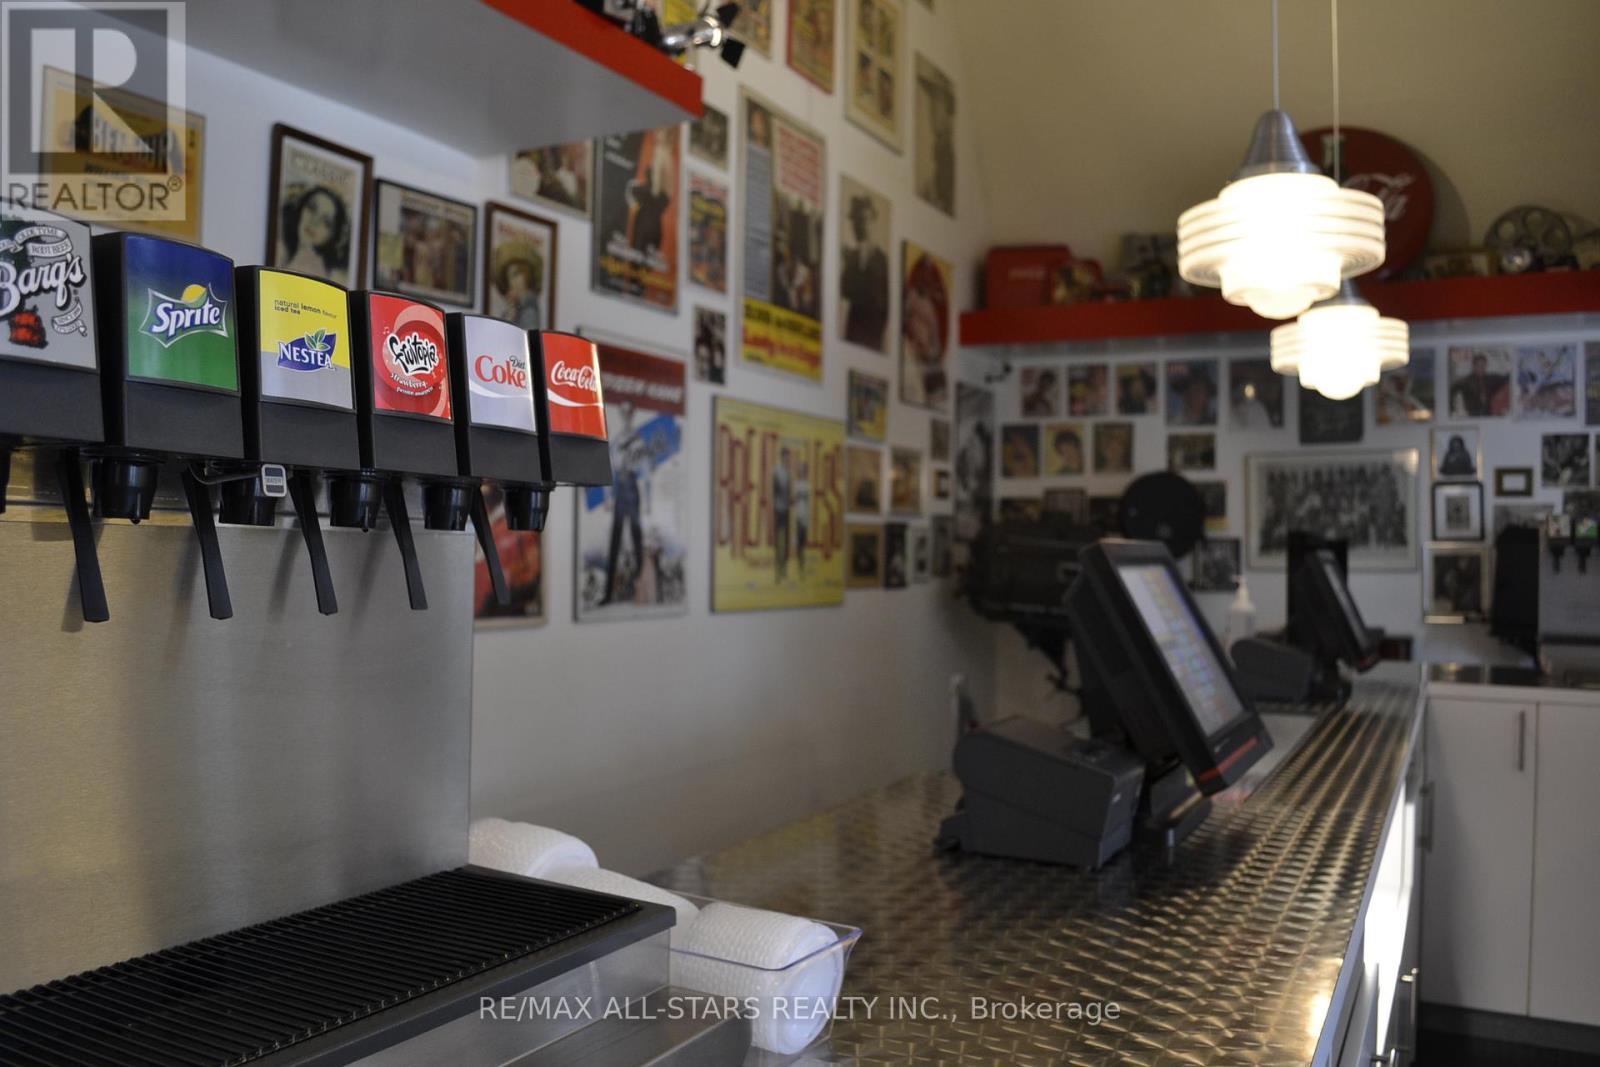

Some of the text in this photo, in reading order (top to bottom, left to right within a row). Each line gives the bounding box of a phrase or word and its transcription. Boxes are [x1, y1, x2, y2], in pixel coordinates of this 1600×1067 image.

[0, 256, 84, 317] Barq's
[152, 298, 220, 337] Sprite
[274, 299, 300, 310] natural
[301, 303, 321, 314] lemon
[290, 308, 301, 316] tea
[279, 342, 333, 369] NESTEA
[509, 355, 526, 369] Diet
[474, 355, 527, 389] Coke
